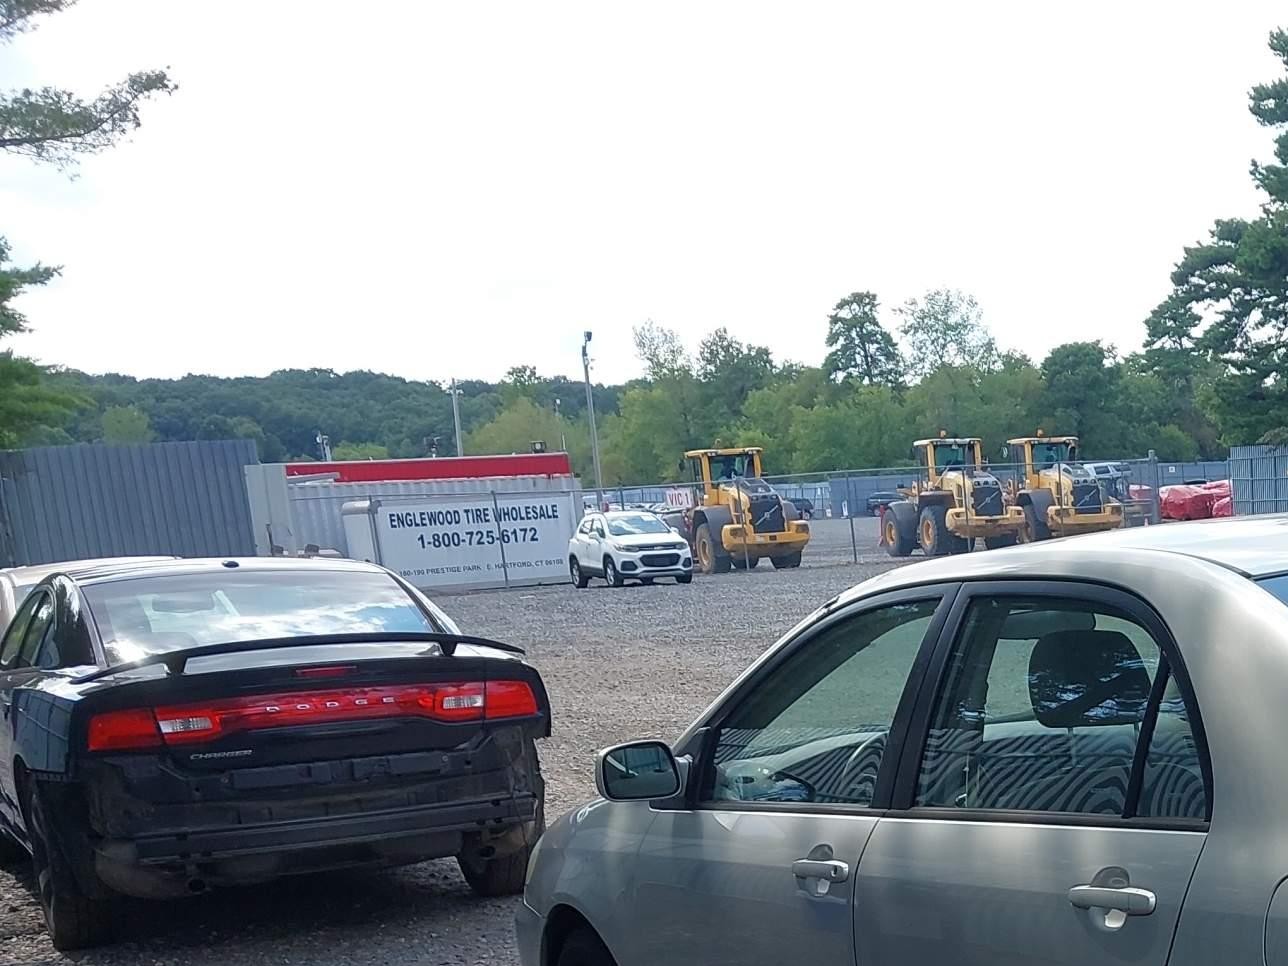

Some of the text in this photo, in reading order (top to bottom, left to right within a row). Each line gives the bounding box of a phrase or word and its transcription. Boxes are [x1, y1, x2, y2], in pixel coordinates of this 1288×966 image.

[667, 492, 684, 507] VIC
[389, 504, 559, 529] ENGLEWOOD TIRE WHOLESALE
[417, 527, 539, 549] 1-800-725-6172
[426, 566, 462, 575] PRESTIGE
[463, 564, 481, 572] PARK
[266, 696, 395, 712] DODGE
[190, 749, 252, 760] CHARGER
